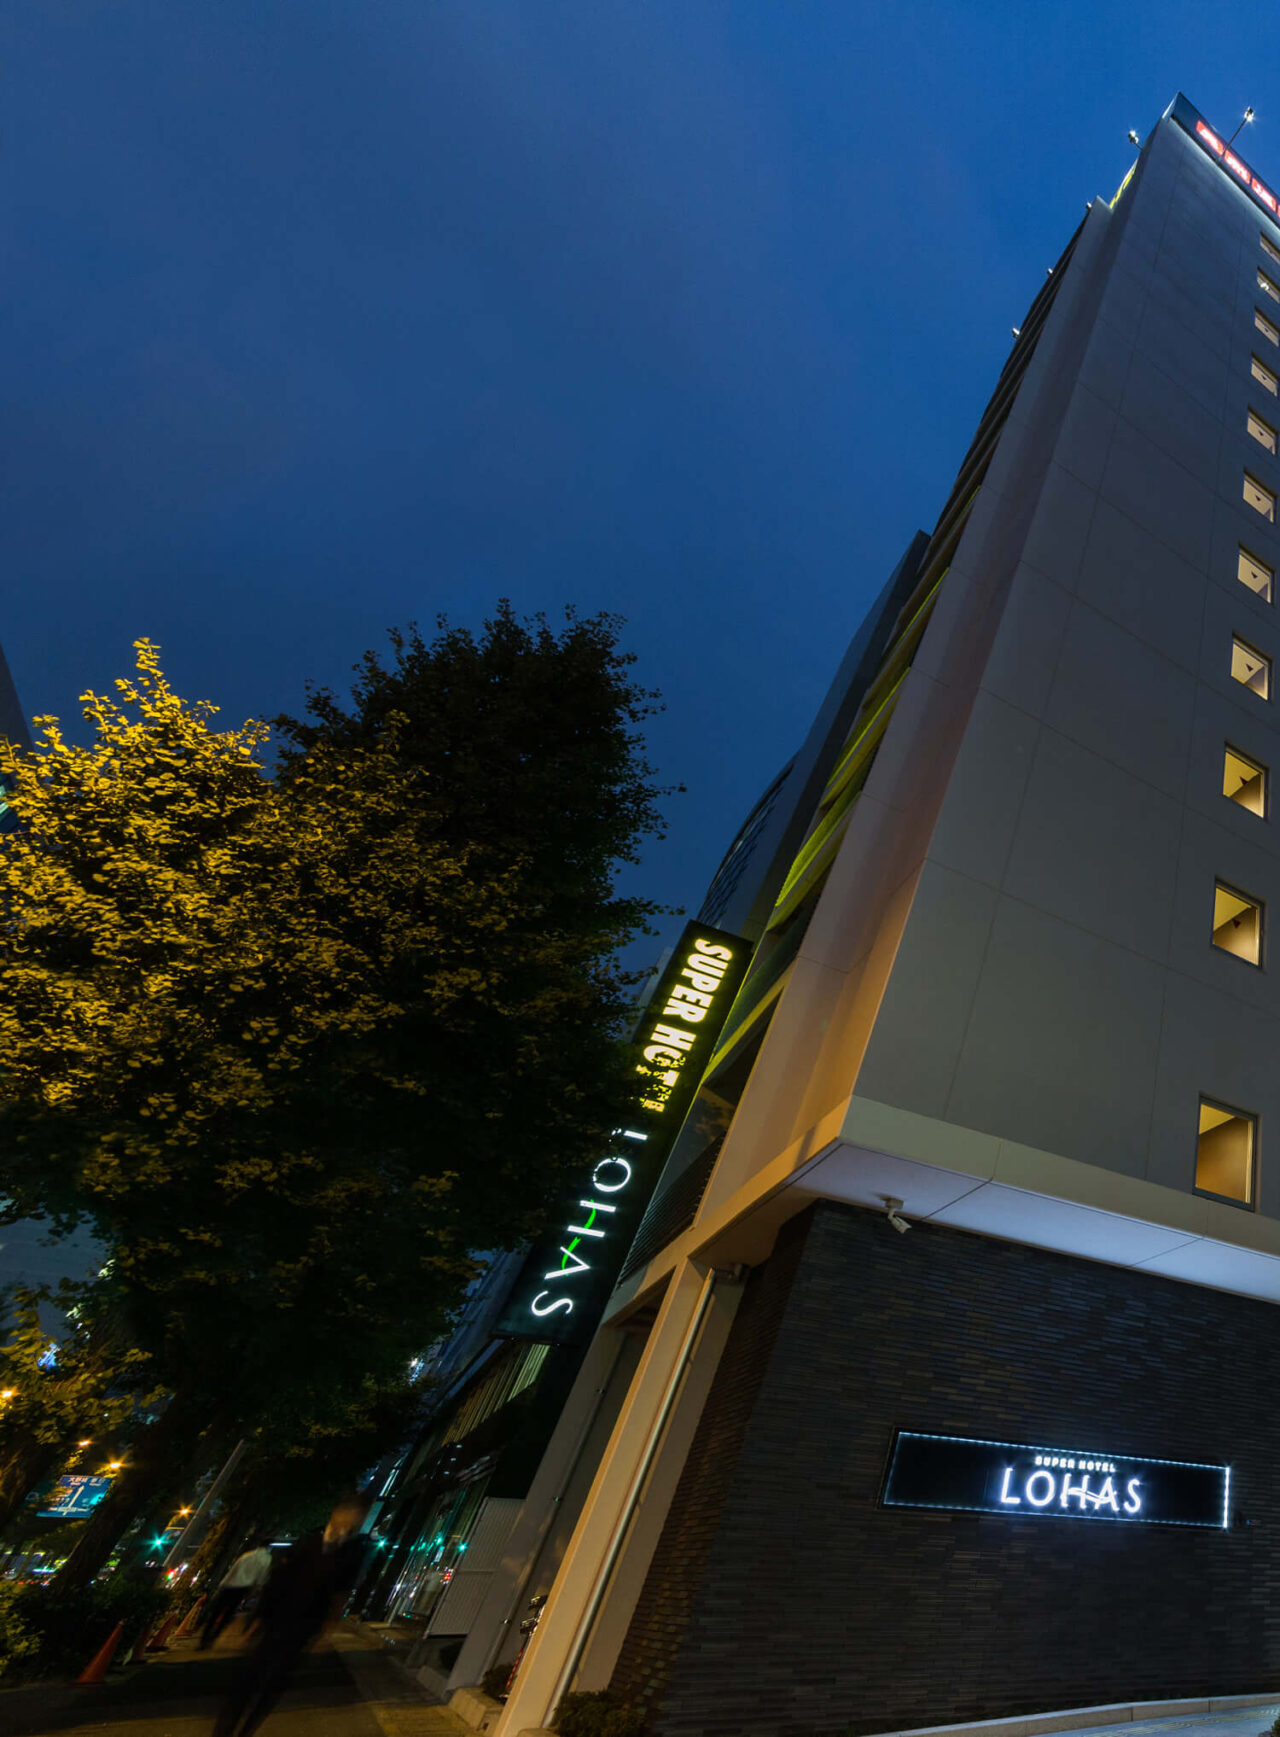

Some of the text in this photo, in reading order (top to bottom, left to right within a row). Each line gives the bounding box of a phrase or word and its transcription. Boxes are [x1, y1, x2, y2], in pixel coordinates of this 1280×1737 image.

[662, 938, 733, 1024] SUPER
[1035, 1455, 1116, 1473] SUPER HOTEL
[1001, 1467, 1142, 1514] LOHAS
